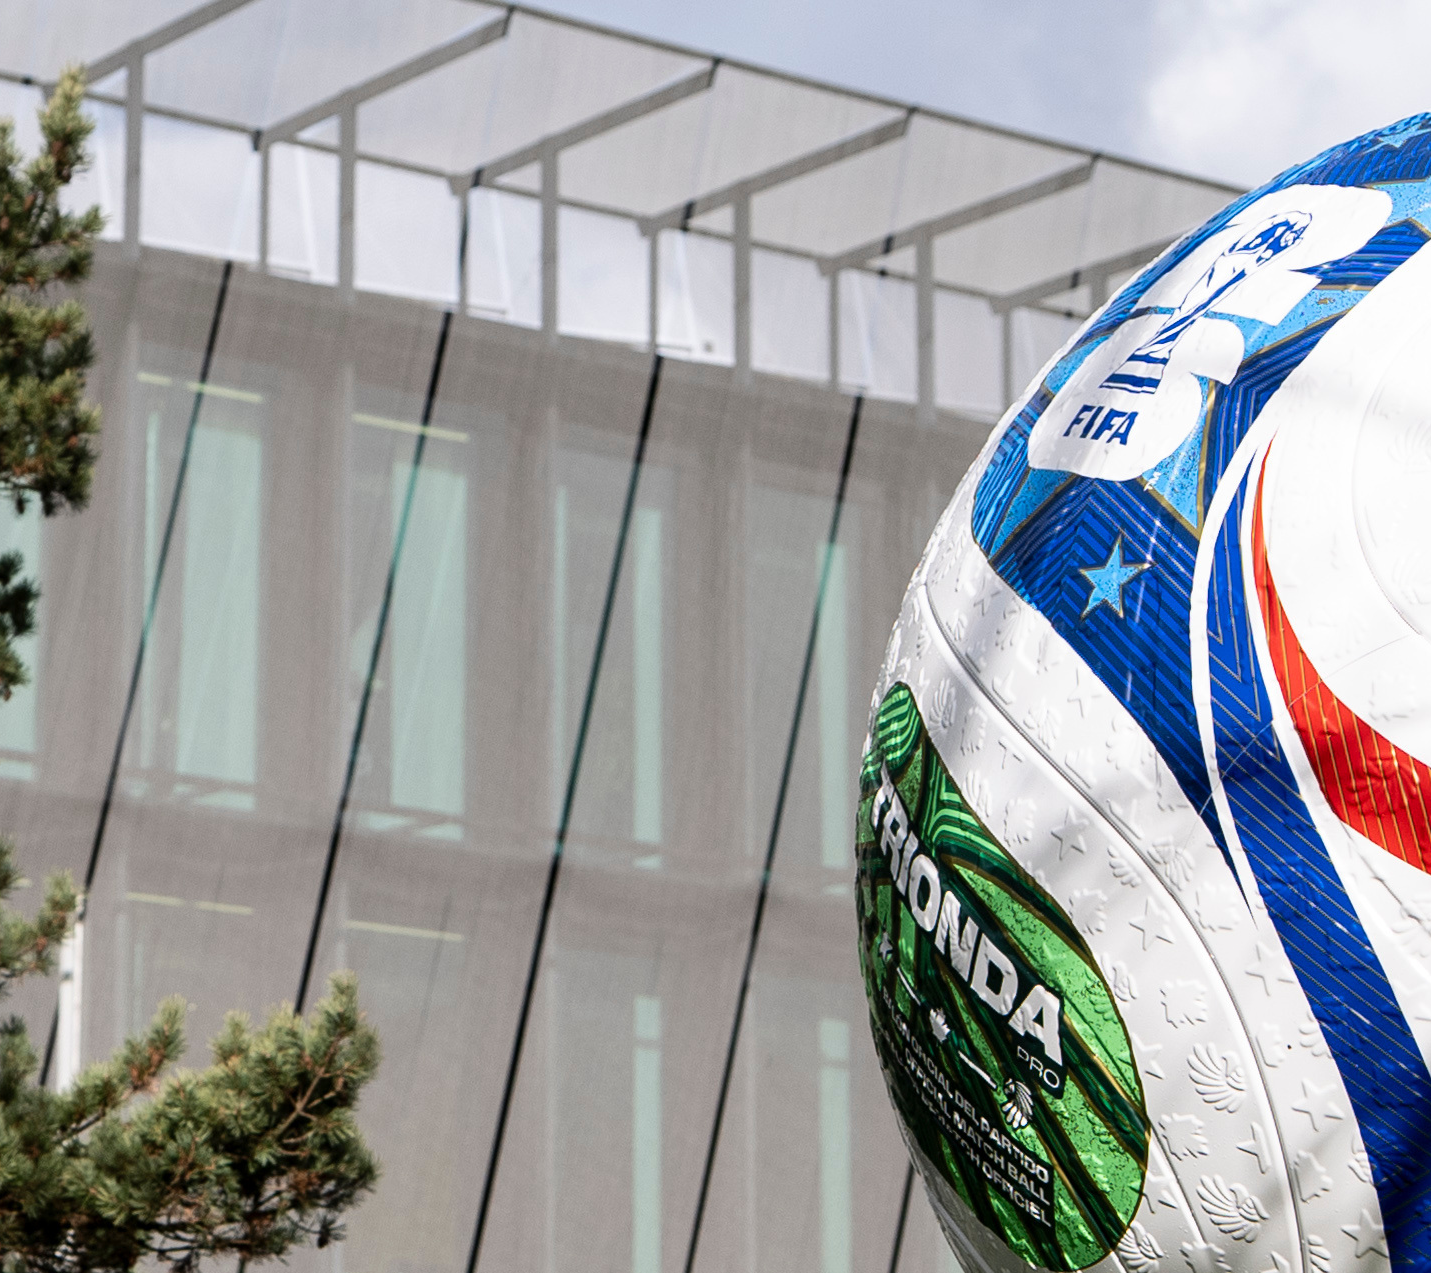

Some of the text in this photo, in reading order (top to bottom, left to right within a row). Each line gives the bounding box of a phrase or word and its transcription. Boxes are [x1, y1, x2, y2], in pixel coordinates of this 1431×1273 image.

[1062, 403, 1139, 446] FIFA
[872, 758, 1063, 1067] TRIONDA
[1016, 1045, 1060, 1089] PRO
[953, 1110, 1005, 1170] MATCH
[1007, 1162, 1051, 1207] BALL
[954, 1090, 980, 1127] DEL
[980, 1116, 1049, 1184] PARTIDO
[981, 1162, 1052, 1228] OFFICIEL
